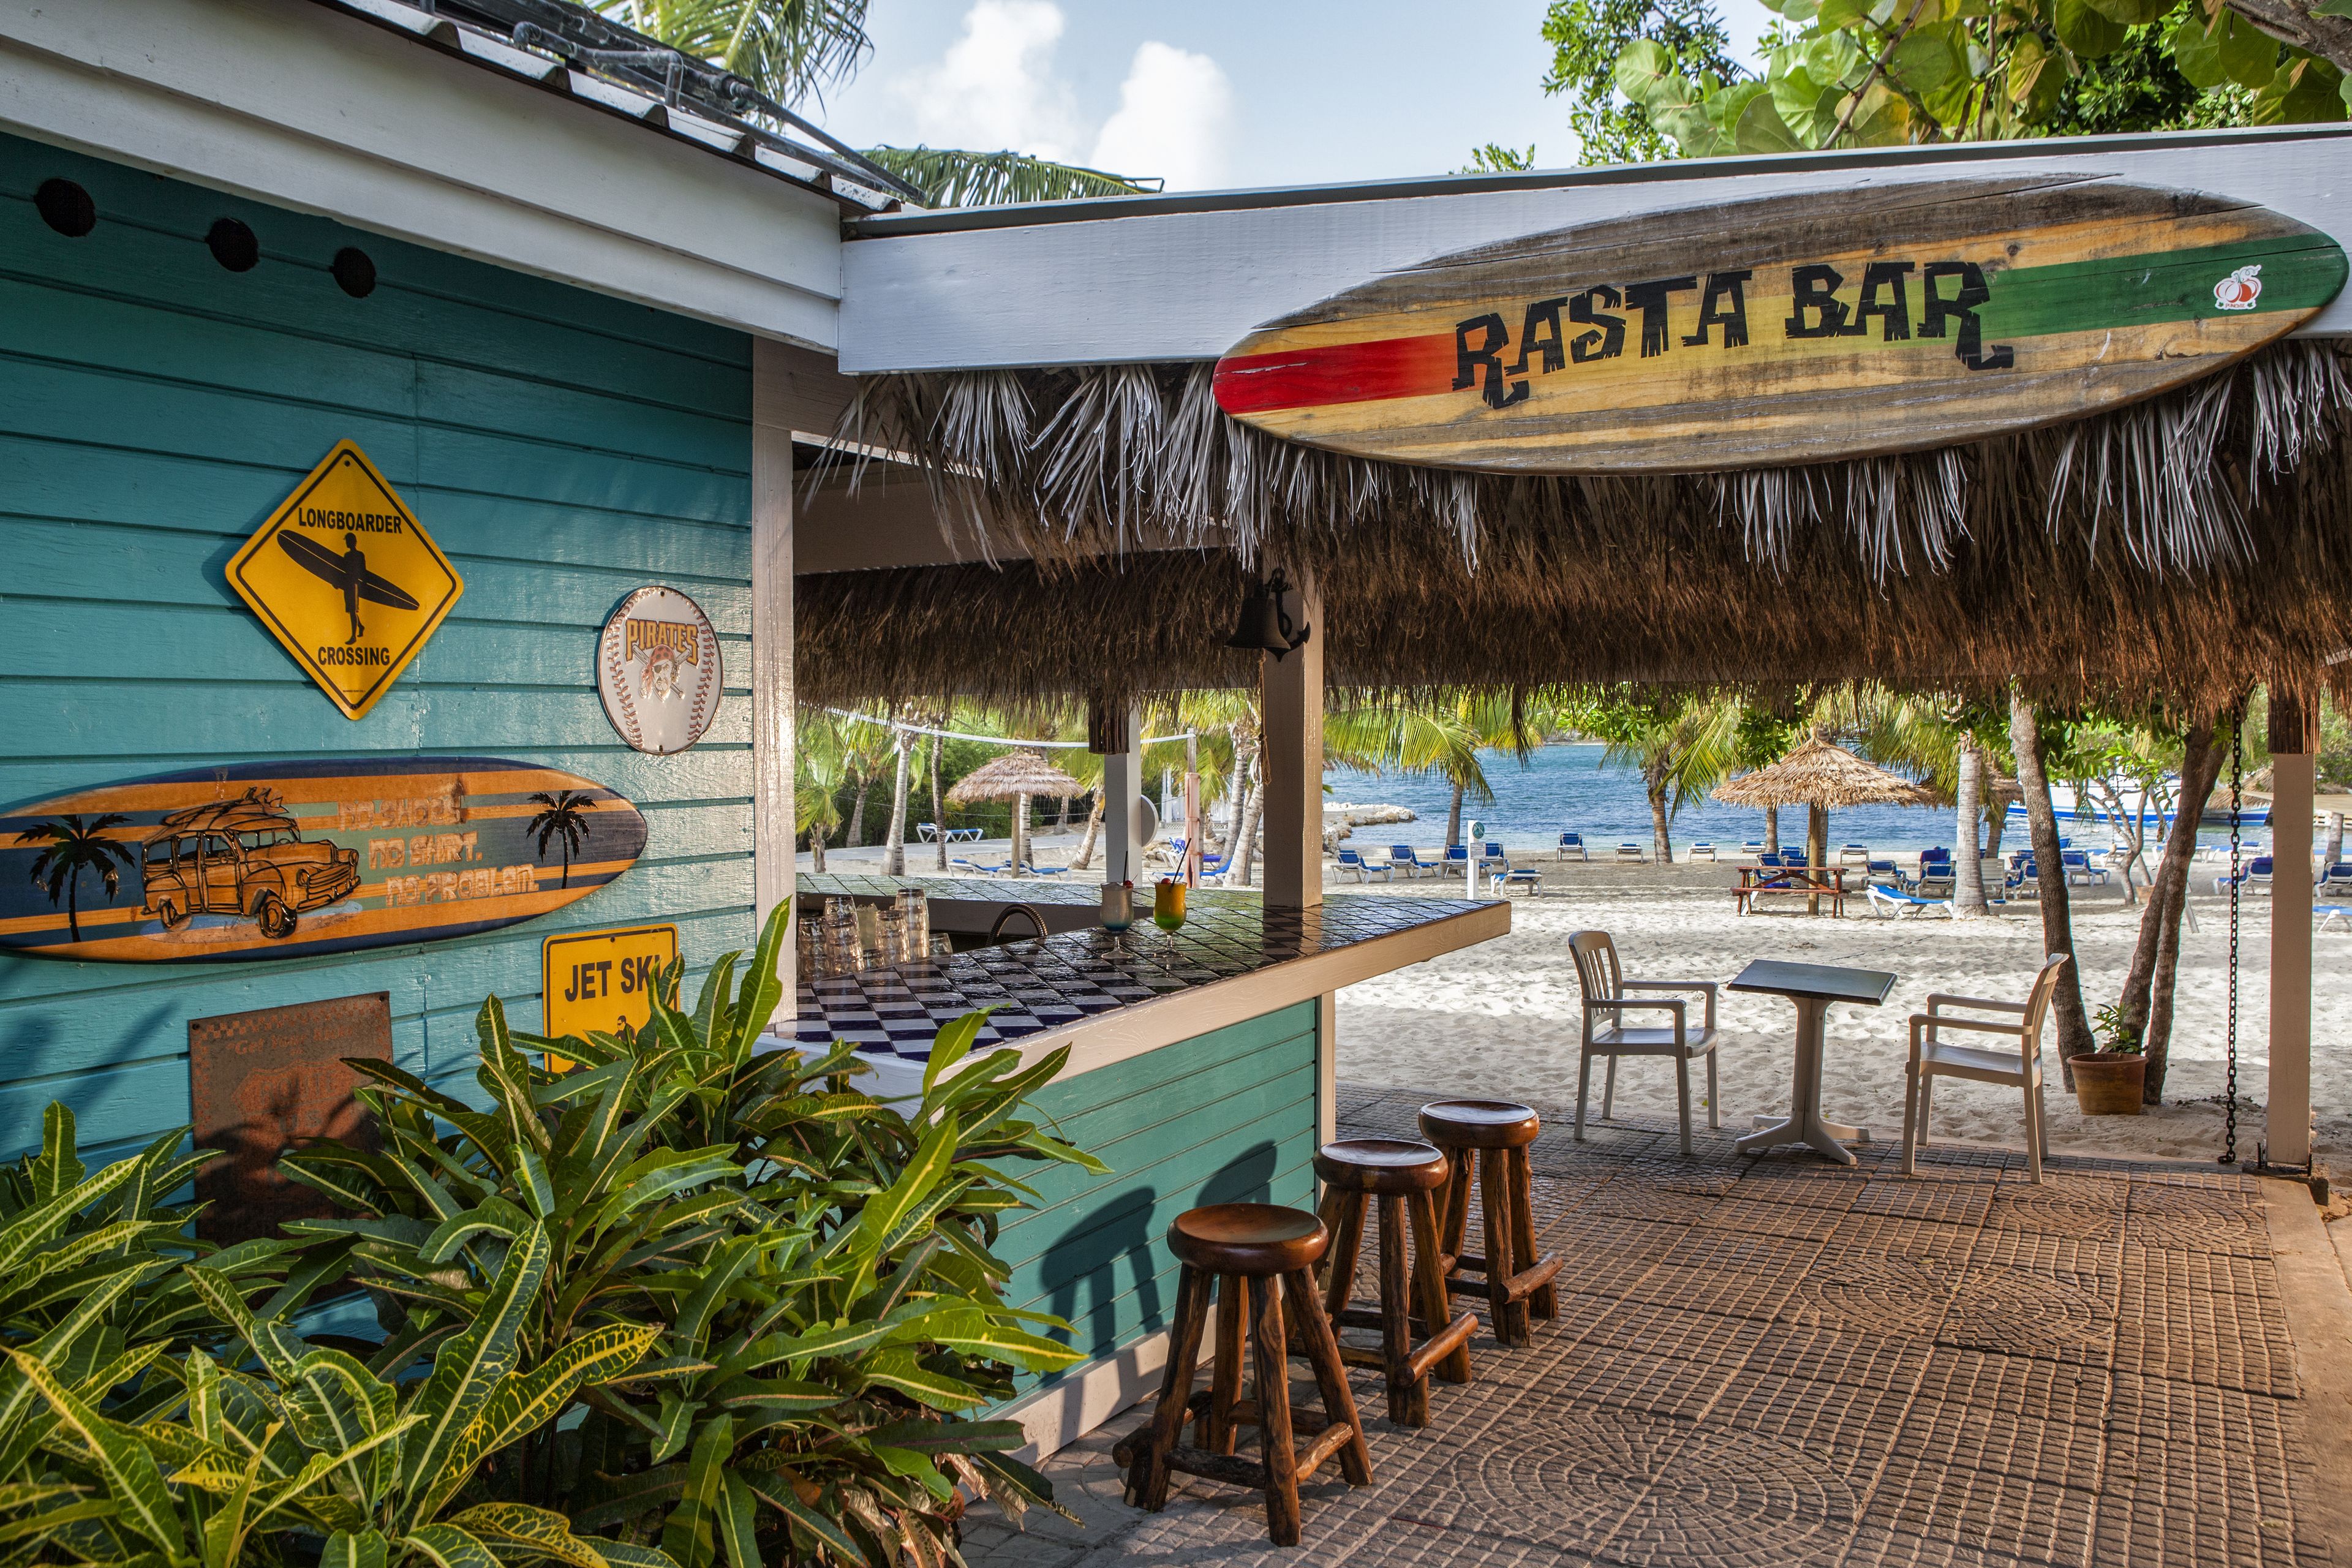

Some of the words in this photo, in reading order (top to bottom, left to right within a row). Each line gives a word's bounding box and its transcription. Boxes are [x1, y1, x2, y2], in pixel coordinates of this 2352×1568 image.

[1451, 270, 1752, 409] RASTA
[1784, 262, 2013, 371] BAR
[298, 507, 402, 534] LONGBOARDER
[318, 646, 390, 666] CROSSING
[625, 618, 699, 666] PIRATES
[564, 960, 612, 1002] JET
